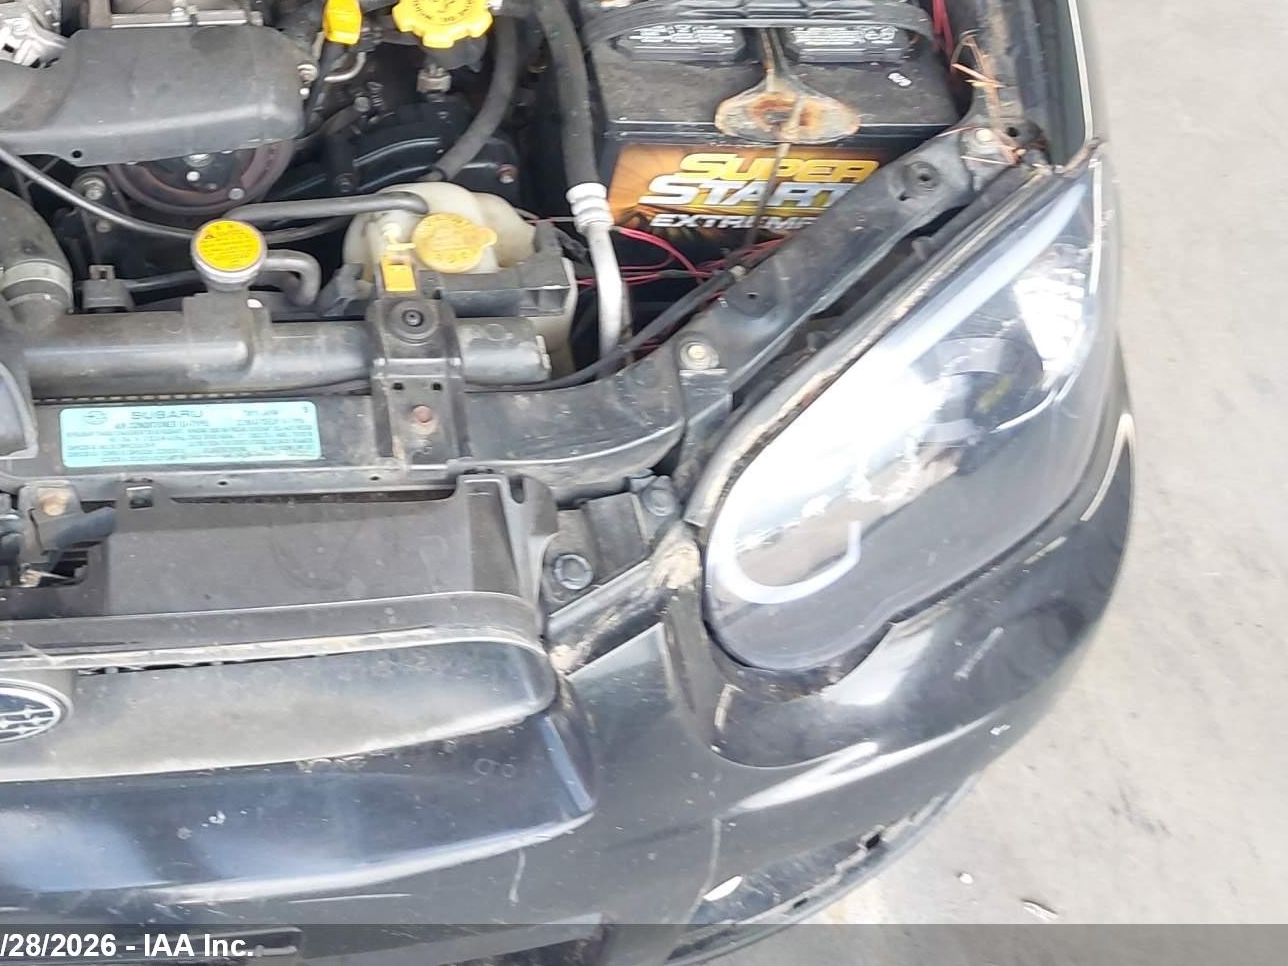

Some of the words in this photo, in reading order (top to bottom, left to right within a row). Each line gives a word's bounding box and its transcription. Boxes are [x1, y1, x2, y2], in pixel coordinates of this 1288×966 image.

[676, 153, 880, 183] SUPER
[638, 174, 859, 207] START
[131, 409, 203, 421] SUBARU
